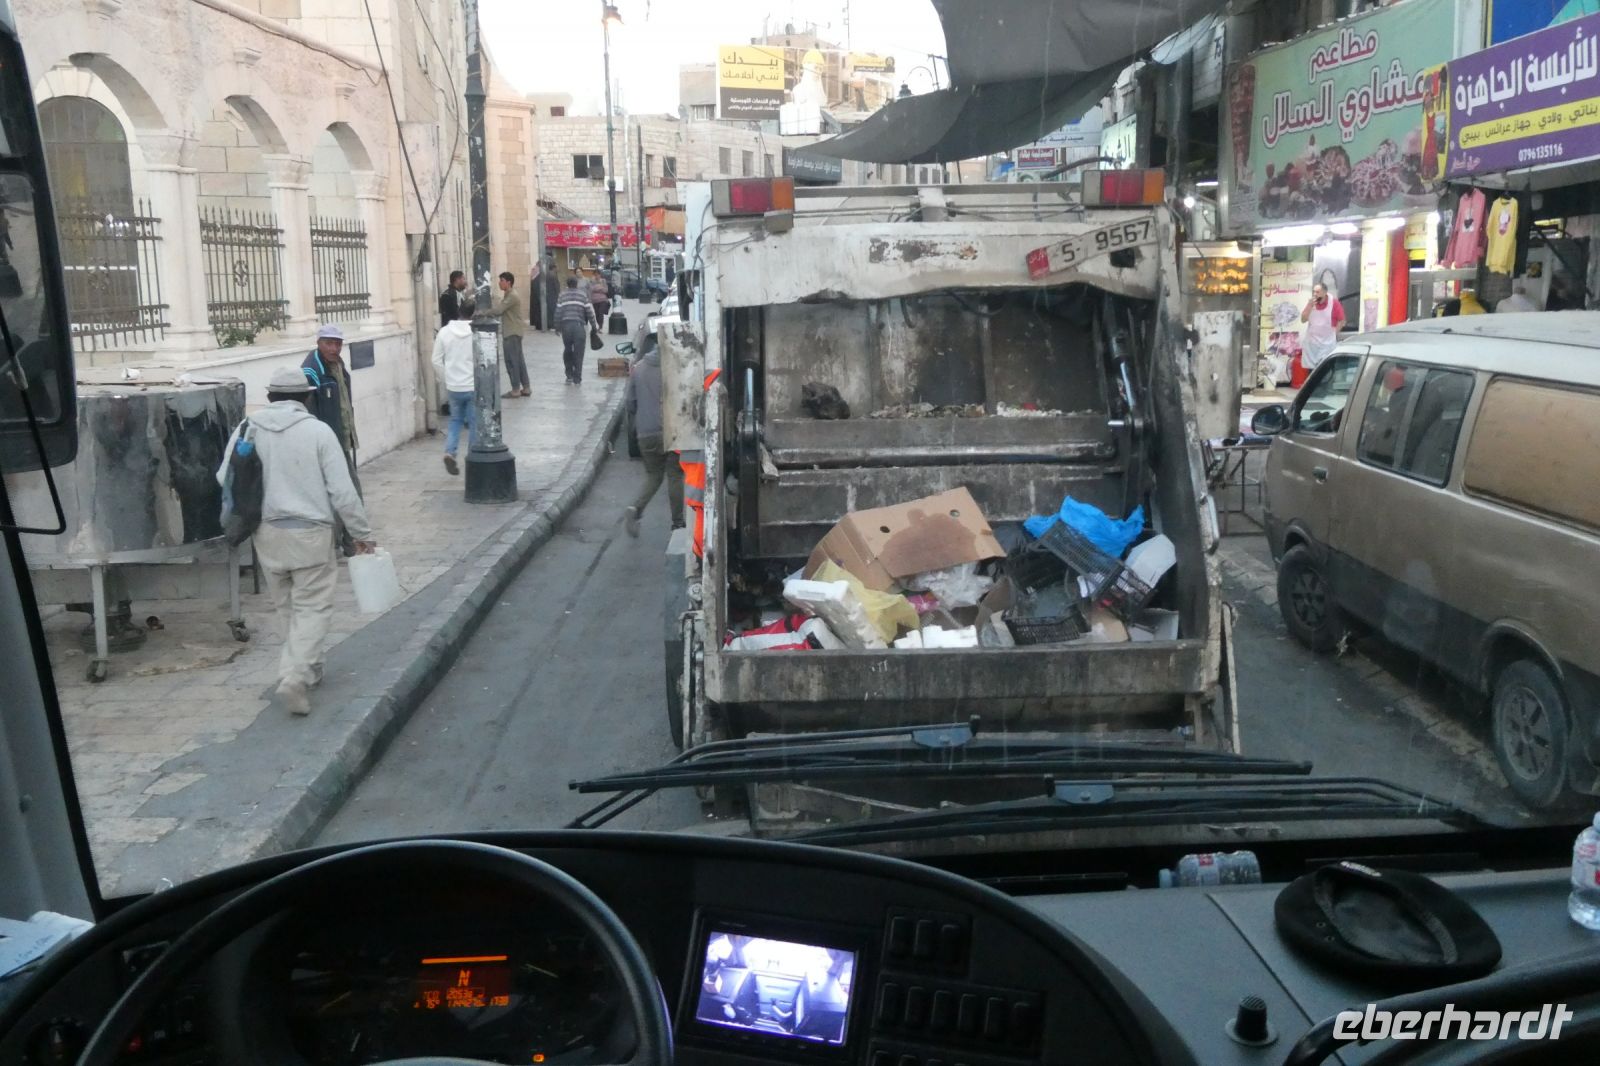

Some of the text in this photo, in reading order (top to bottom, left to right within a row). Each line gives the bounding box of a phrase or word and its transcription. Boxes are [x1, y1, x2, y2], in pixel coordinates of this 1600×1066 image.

[1310, 28, 1379, 83] مطاعم
[1455, 26, 1597, 116] للألبسة الجاهزة
[1263, 80, 1334, 148] السلال
[1518, 143, 1563, 161] 0796135116
[1095, 220, 1150, 251] 9567
[457, 969, 471, 987] N
